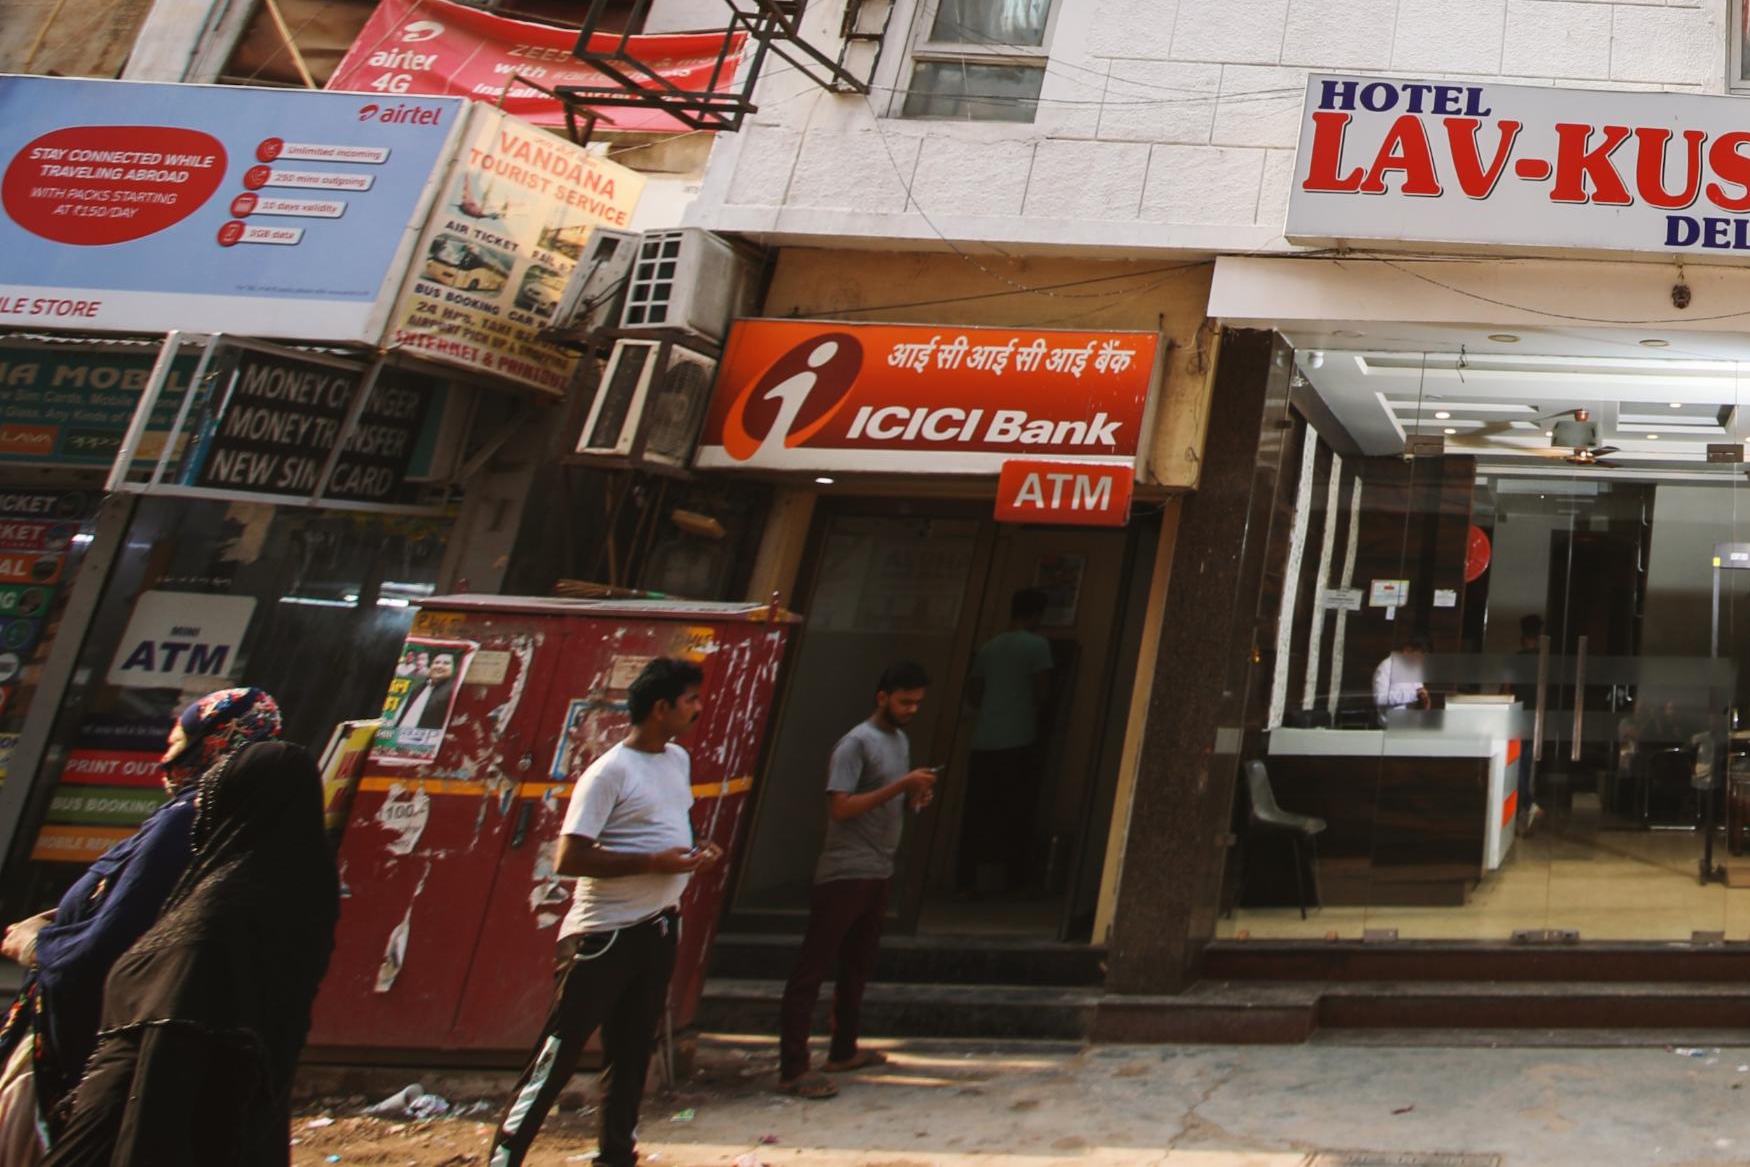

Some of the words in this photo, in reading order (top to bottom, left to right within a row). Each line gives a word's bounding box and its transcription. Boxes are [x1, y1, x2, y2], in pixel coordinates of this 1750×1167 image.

[368, 47, 438, 72] airtel
[493, 62, 547, 80] with
[371, 74, 413, 94] 4G
[1317, 80, 1492, 117] HOTEL
[379, 105, 443, 125] airtel
[29, 147, 68, 160] STAY
[67, 149, 162, 166] CONNECTED
[163, 153, 216, 169] WHILE
[287, 146, 336, 158] Unlimited
[336, 149, 384, 161] incoming
[40, 165, 124, 181] TRAVELING
[125, 169, 190, 184] ABROAD
[499, 131, 616, 201] VANDANA
[321, 175, 368, 188] outgoing
[469, 148, 554, 196] TOURIST
[554, 185, 628, 227] SERVICE
[29, 187, 67, 200] WITH
[67, 189, 111, 202] PACKS
[112, 191, 179, 205] STARTING
[53, 204, 72, 215] AT
[445, 221, 469, 236] AIR
[473, 228, 520, 253] TICKET
[29, 298, 101, 318] STORE
[415, 283, 441, 298] BUS
[445, 290, 501, 316] BOOKING
[508, 310, 535, 326] CAR
[482, 353, 494, 368] &
[886, 335, 941, 371] आई
[936, 336, 965, 371] सी
[966, 338, 1018, 376] आई
[1015, 338, 1047, 375] सी
[1045, 341, 1097, 378] आई
[1094, 340, 1137, 375] बैंक
[240, 363, 329, 406] MONEY
[328, 377, 421, 420] CHNGER
[225, 405, 315, 445] MONEY
[846, 406, 984, 442] ICICI
[984, 409, 1123, 446] Bank
[208, 449, 281, 485] NEW
[328, 463, 395, 497] CARD
[1012, 472, 1114, 511] ATM
[120, 640, 230, 676] ATM
[65, 759, 120, 775] PRINT
[123, 760, 161, 775] OUT
[51, 795, 83, 811] BUS
[86, 797, 160, 814] BOOKING
